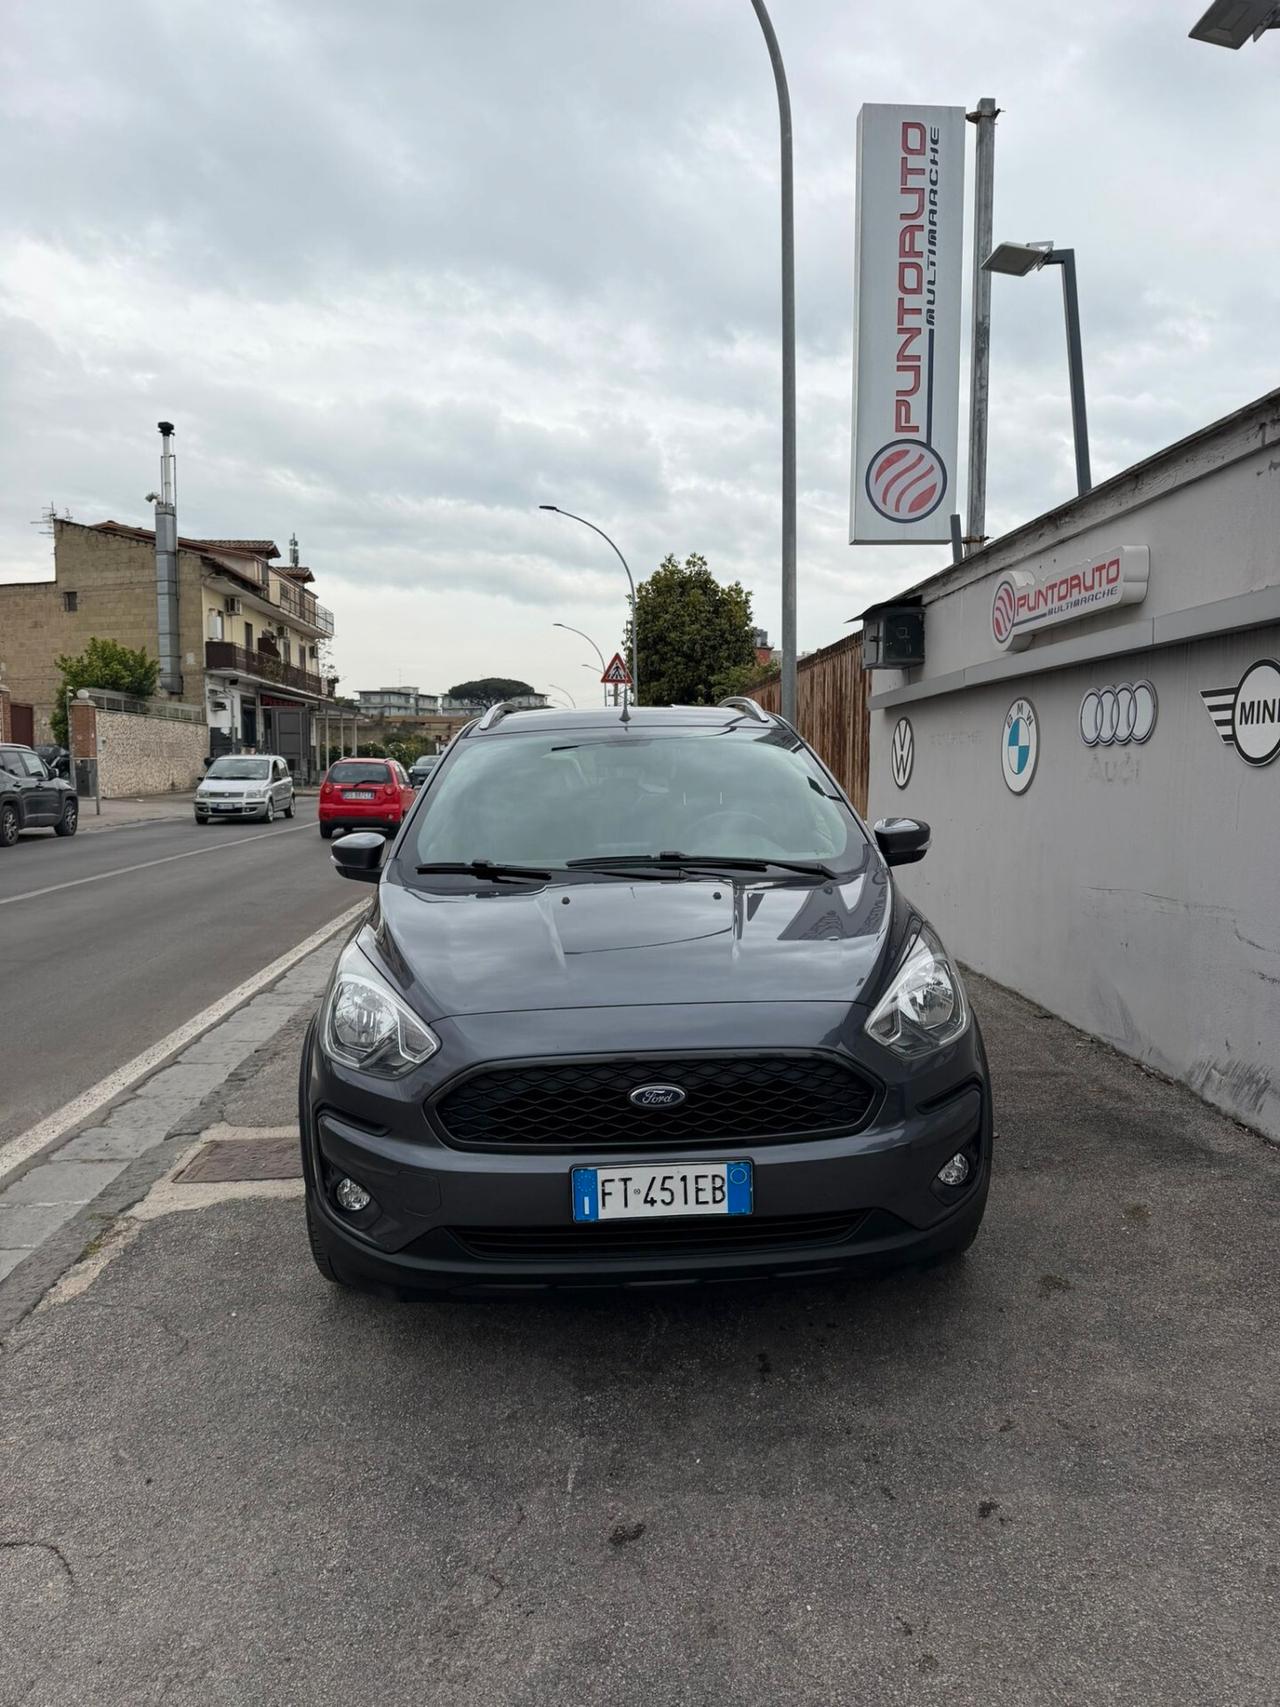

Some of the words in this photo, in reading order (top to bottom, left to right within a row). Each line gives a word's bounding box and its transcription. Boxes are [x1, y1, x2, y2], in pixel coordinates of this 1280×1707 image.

[926, 126, 939, 326] MULTIMARCHE
[895, 121, 927, 432] PUNTOAUTO
[1017, 558, 1120, 616] PUNTOAUTO
[1047, 585, 1118, 616] MULTIMARCHE
[1007, 703, 1034, 729] BMW
[642, 1090, 673, 1103] Ford
